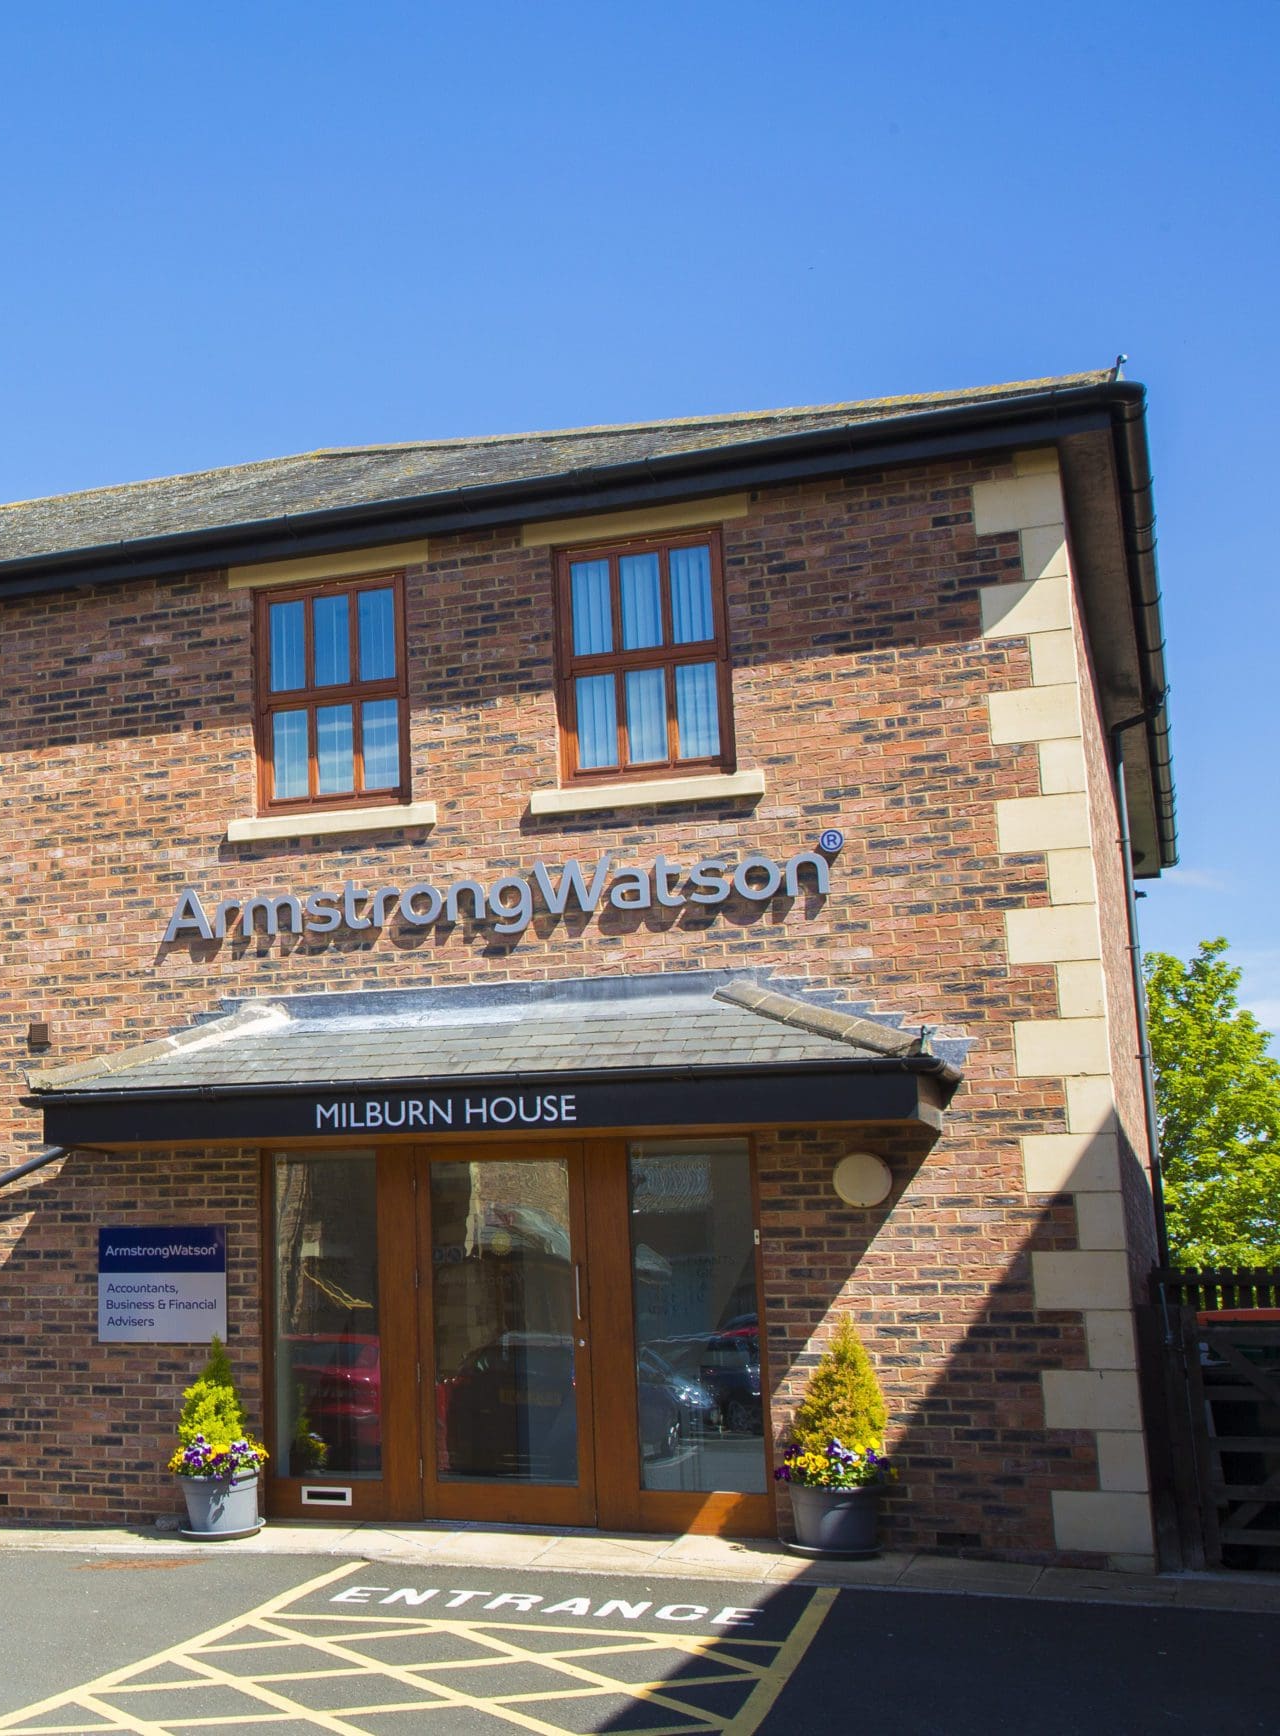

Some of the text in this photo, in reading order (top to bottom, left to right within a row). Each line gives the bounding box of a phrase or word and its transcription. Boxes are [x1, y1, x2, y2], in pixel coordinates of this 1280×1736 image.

[316, 1095, 577, 1128] MILBURN HOUSE
[106, 1283, 179, 1295] Accountants,
[106, 1299, 217, 1310] Business & Financial
[106, 1316, 155, 1327] Advisers
[328, 1586, 766, 1627] ENTRANCE
